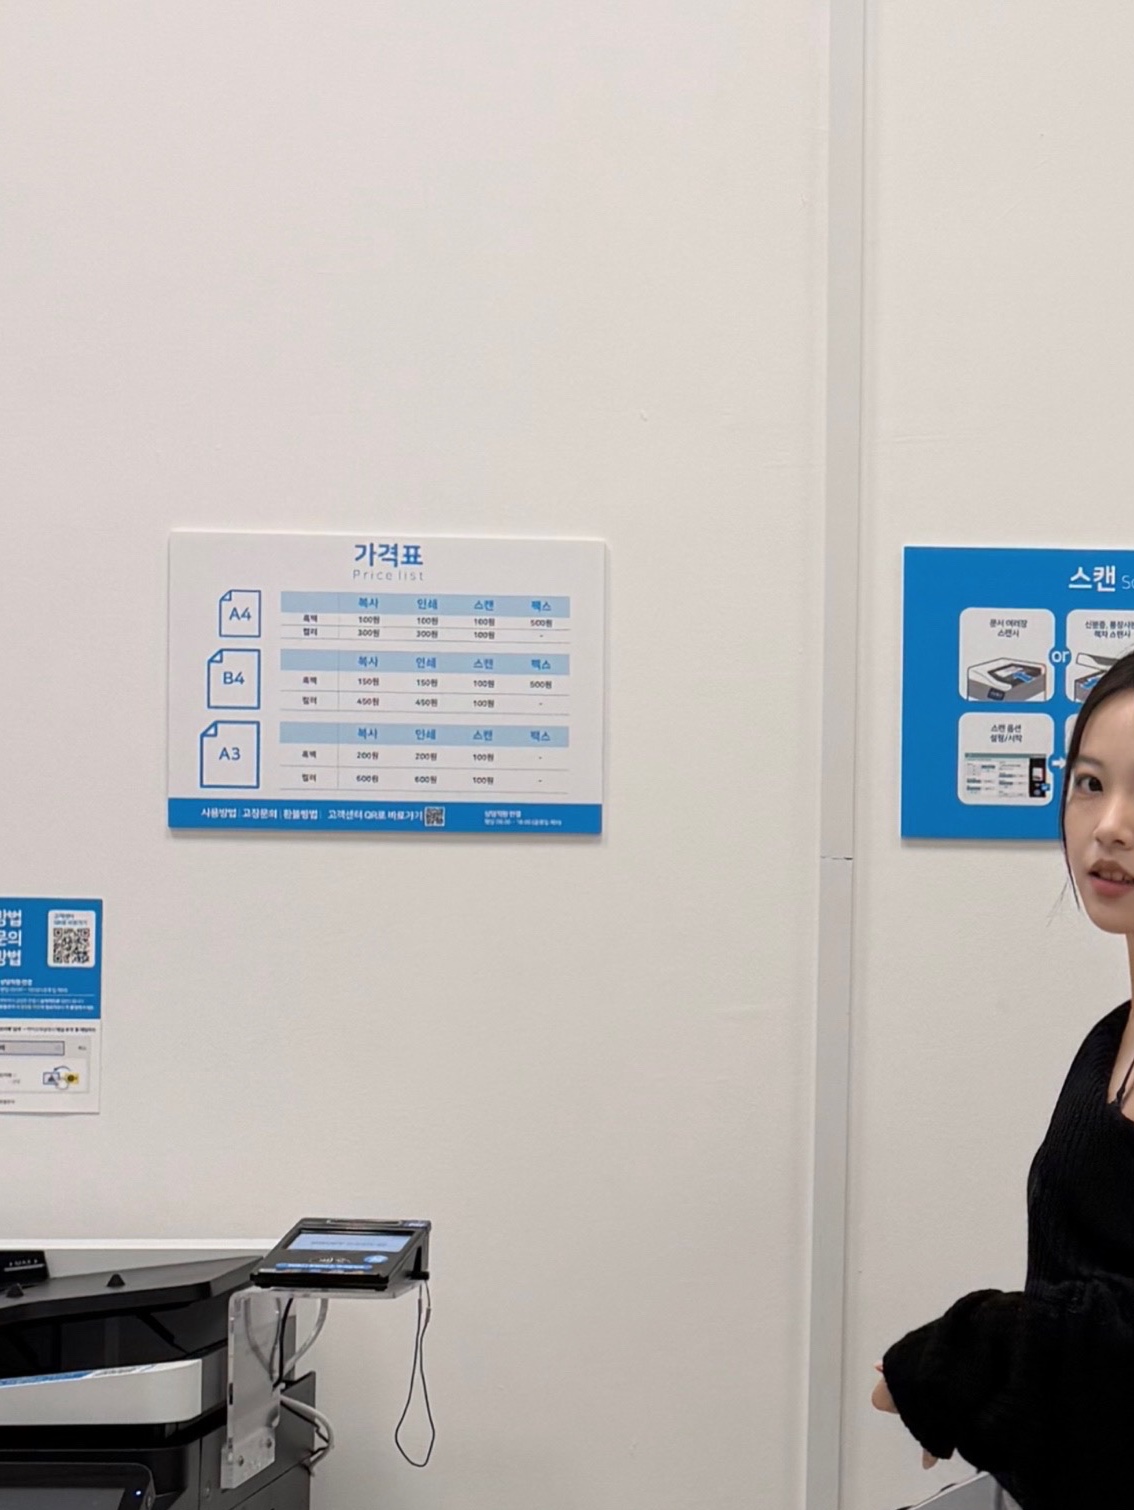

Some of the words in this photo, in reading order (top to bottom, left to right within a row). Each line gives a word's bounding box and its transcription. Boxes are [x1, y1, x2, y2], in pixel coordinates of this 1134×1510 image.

[354, 543, 423, 567] 가격표
[353, 569, 393, 581] Price
[399, 570, 424, 581] list
[1068, 565, 1116, 592] 스캔
[358, 597, 379, 609] 복사
[417, 598, 438, 611] 인쇄
[474, 600, 494, 612] 스캔
[532, 601, 551, 612] 팩스
[229, 607, 251, 621] A4
[358, 616, 380, 625] 100원
[417, 616, 438, 626] 100원
[474, 618, 495, 627] 100원
[530, 619, 552, 628] 500원
[990, 619, 1004, 628] 문서
[358, 629, 380, 638] 300원
[474, 631, 495, 640] 100원
[358, 656, 378, 668] 복사
[416, 657, 437, 669] 인쇄
[473, 658, 493, 670] 스캔
[531, 659, 551, 670] 팩스
[1051, 651, 1070, 663] or
[223, 671, 245, 685] B4
[358, 677, 379, 687] 150원
[416, 678, 438, 688] 150원
[473, 679, 495, 689] 100원
[530, 680, 552, 689] 500원
[356, 697, 379, 707] 450원
[415, 698, 438, 708] 450원
[473, 699, 495, 709] 100원
[358, 728, 378, 740] 복사
[415, 729, 436, 741] 인쇄
[473, 730, 493, 742] 스캔
[531, 730, 550, 742] 팩스
[219, 747, 241, 760] A3
[356, 751, 379, 761] 200원
[415, 752, 437, 762] 200원
[473, 753, 494, 763] 100원
[356, 774, 379, 783] 600원
[414, 775, 437, 784] 600원
[473, 776, 494, 785] 100원
[201, 807, 237, 819] 사용방법
[242, 808, 278, 819] 고장문의
[283, 808, 318, 820] 환불방법
[328, 809, 363, 820] 고객센터
[364, 810, 386, 820] QR로
[388, 810, 423, 821] 바로가기
